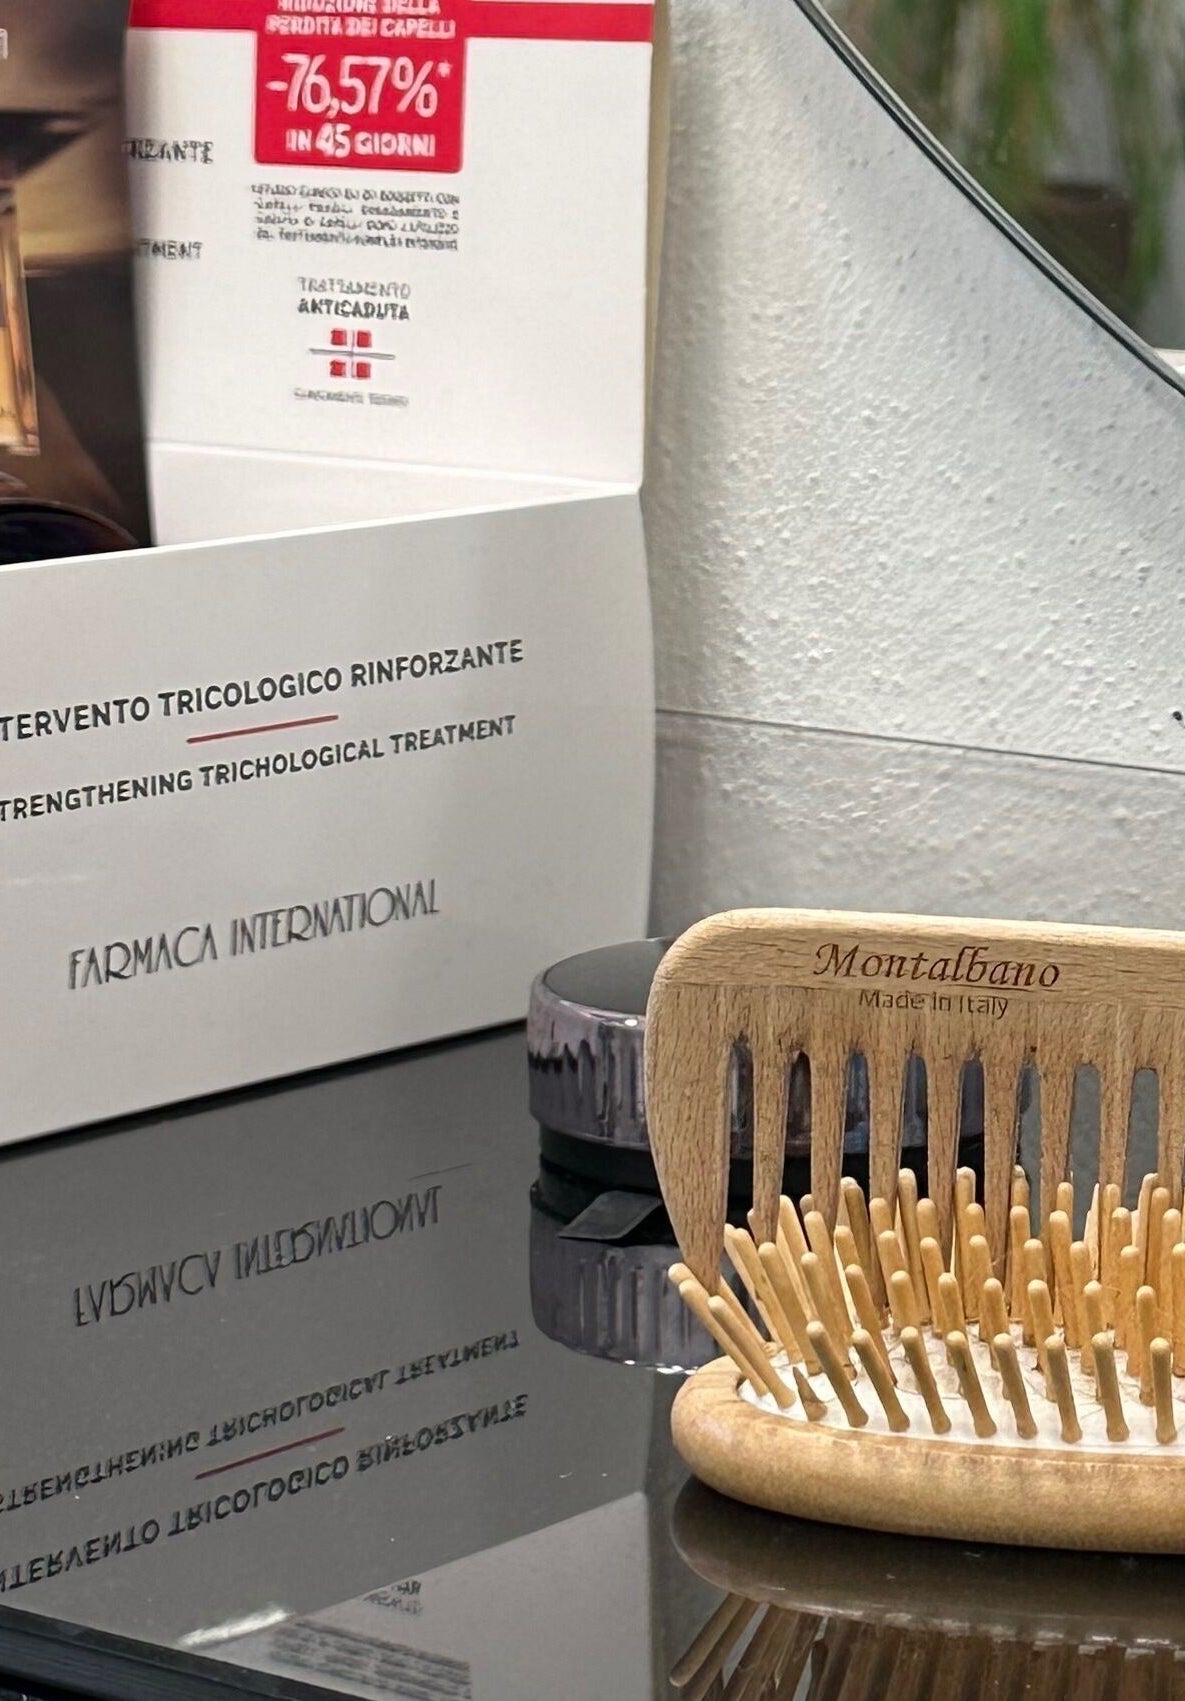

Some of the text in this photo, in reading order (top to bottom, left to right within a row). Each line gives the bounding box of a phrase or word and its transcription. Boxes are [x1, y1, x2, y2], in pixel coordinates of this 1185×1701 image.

[265, 15, 456, 39] PERDITA DEI CAPELLI
[285, 122, 435, 158] IN 45 GIORNI
[297, 298, 410, 320] ANTICADUTA
[158, 667, 342, 717] TRICOLOGICO
[351, 639, 523, 687] RINFORZANTE
[199, 738, 385, 787] TRICHOLOGICAL
[390, 715, 516, 754] TREATMENT
[67, 878, 440, 990] FARMACA INTERNATIONAL
[813, 943, 1061, 987] Montalbano
[858, 990, 925, 1010] Made
[959, 994, 1009, 1020] Italy
